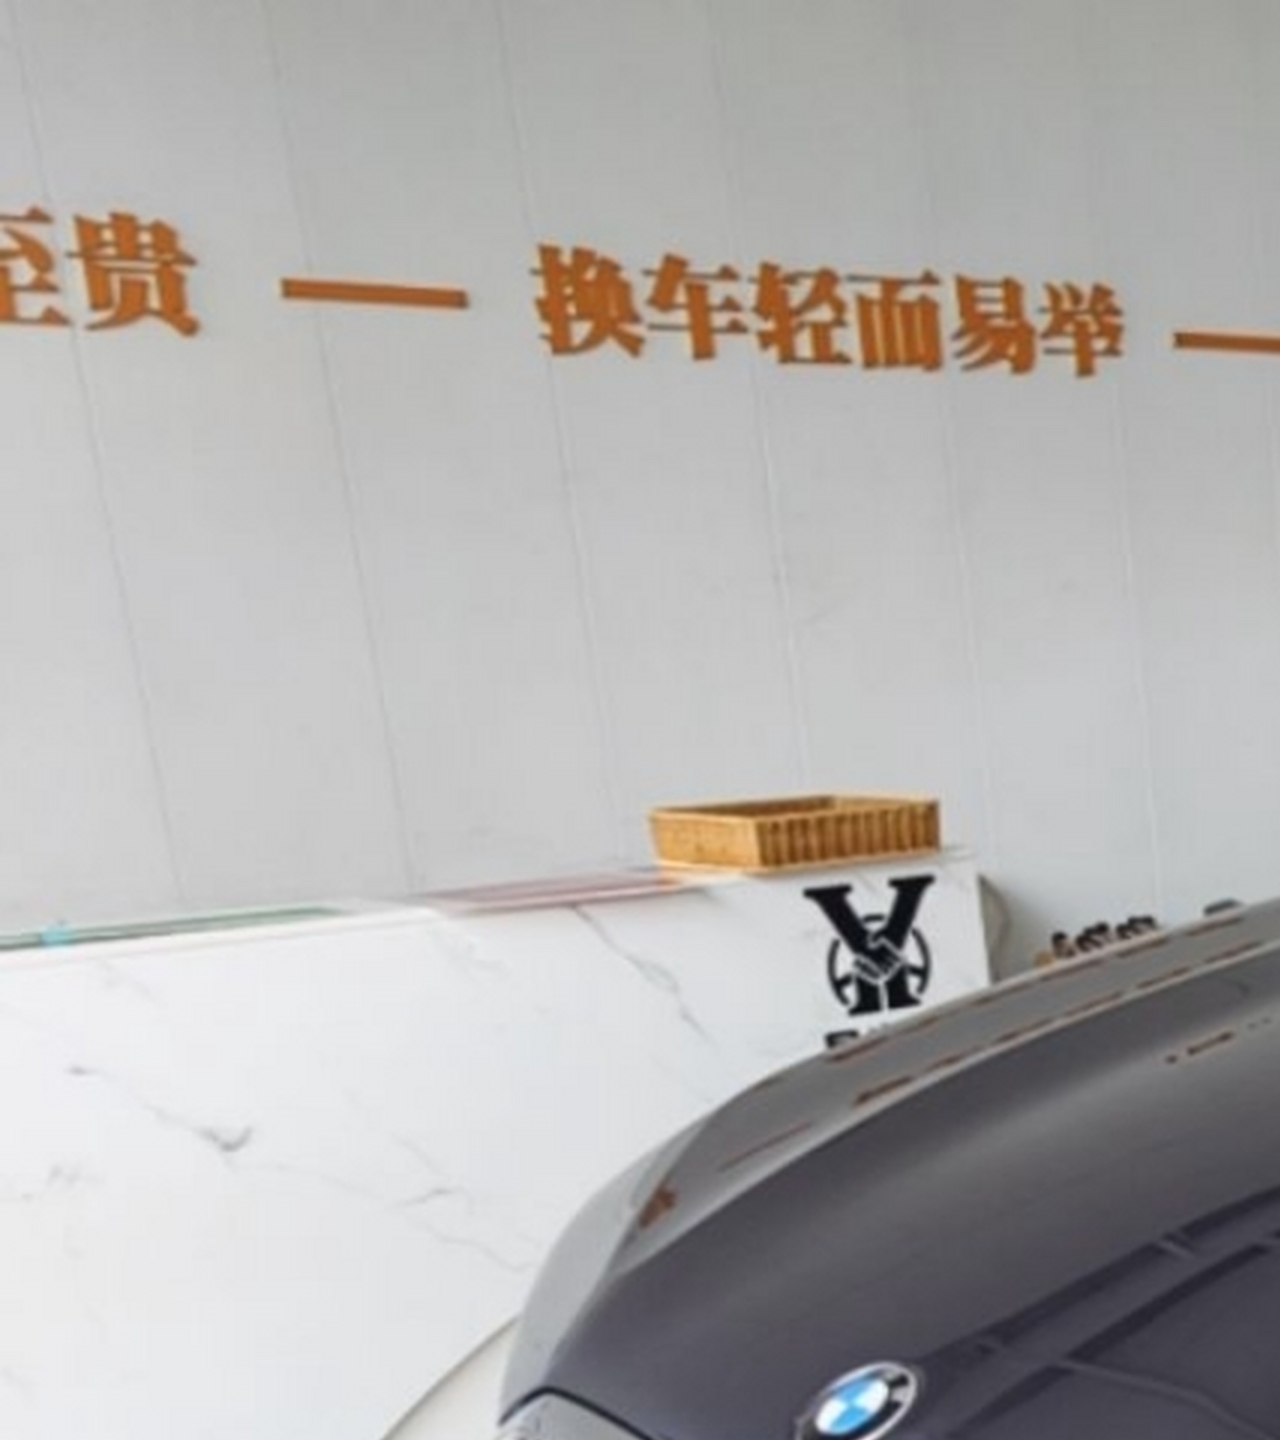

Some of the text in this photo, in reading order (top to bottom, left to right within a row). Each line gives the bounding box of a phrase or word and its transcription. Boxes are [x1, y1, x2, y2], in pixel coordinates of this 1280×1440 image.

[531, 243, 1124, 376] 换车轻而易举
